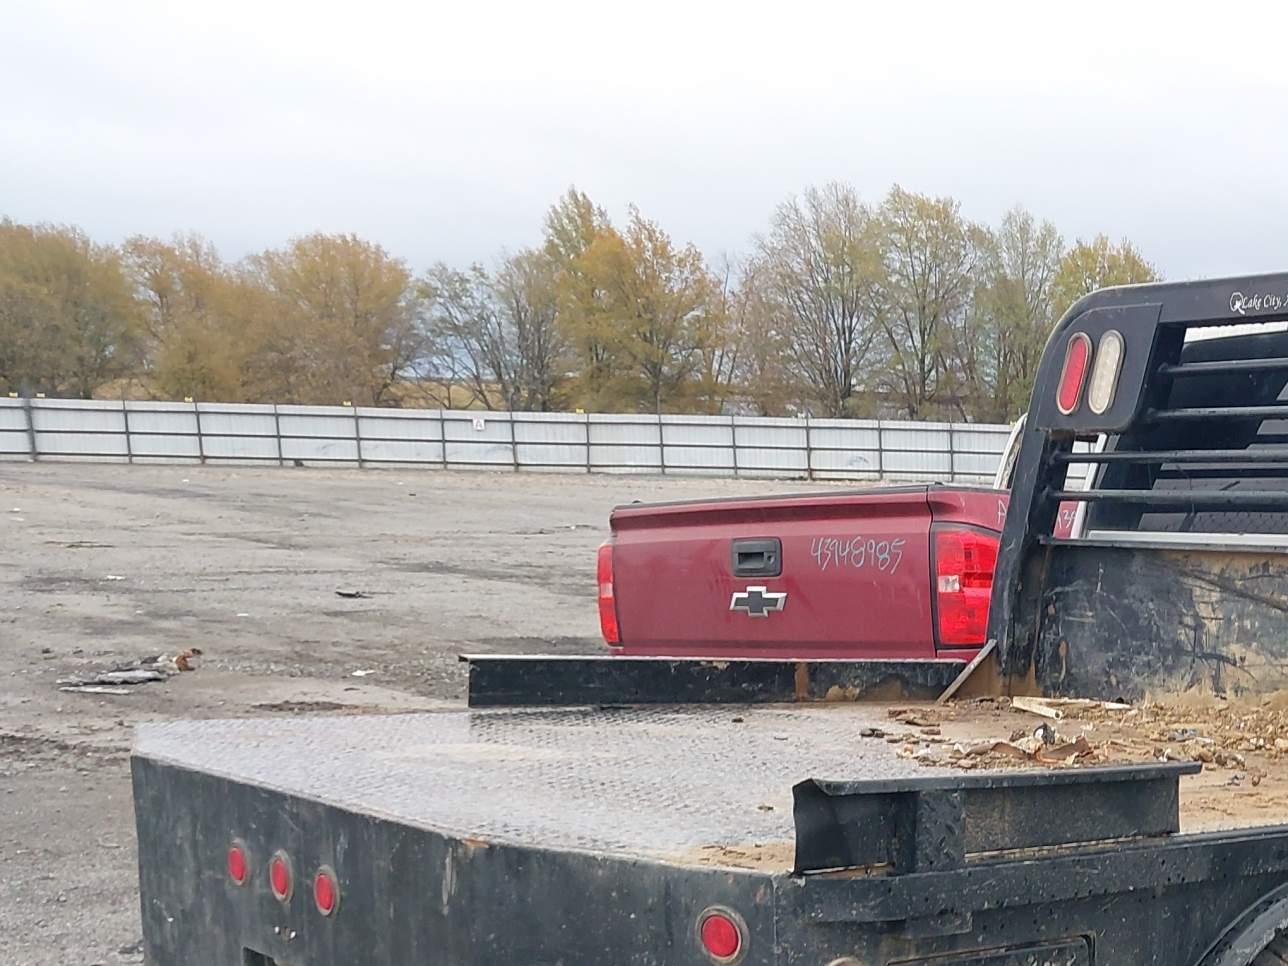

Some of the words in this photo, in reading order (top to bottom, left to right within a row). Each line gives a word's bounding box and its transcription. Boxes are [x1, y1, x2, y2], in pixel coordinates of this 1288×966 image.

[1241, 294, 1262, 310] Lake
[1263, 294, 1282, 310] City,
[811, 536, 906, 574] 43948985
